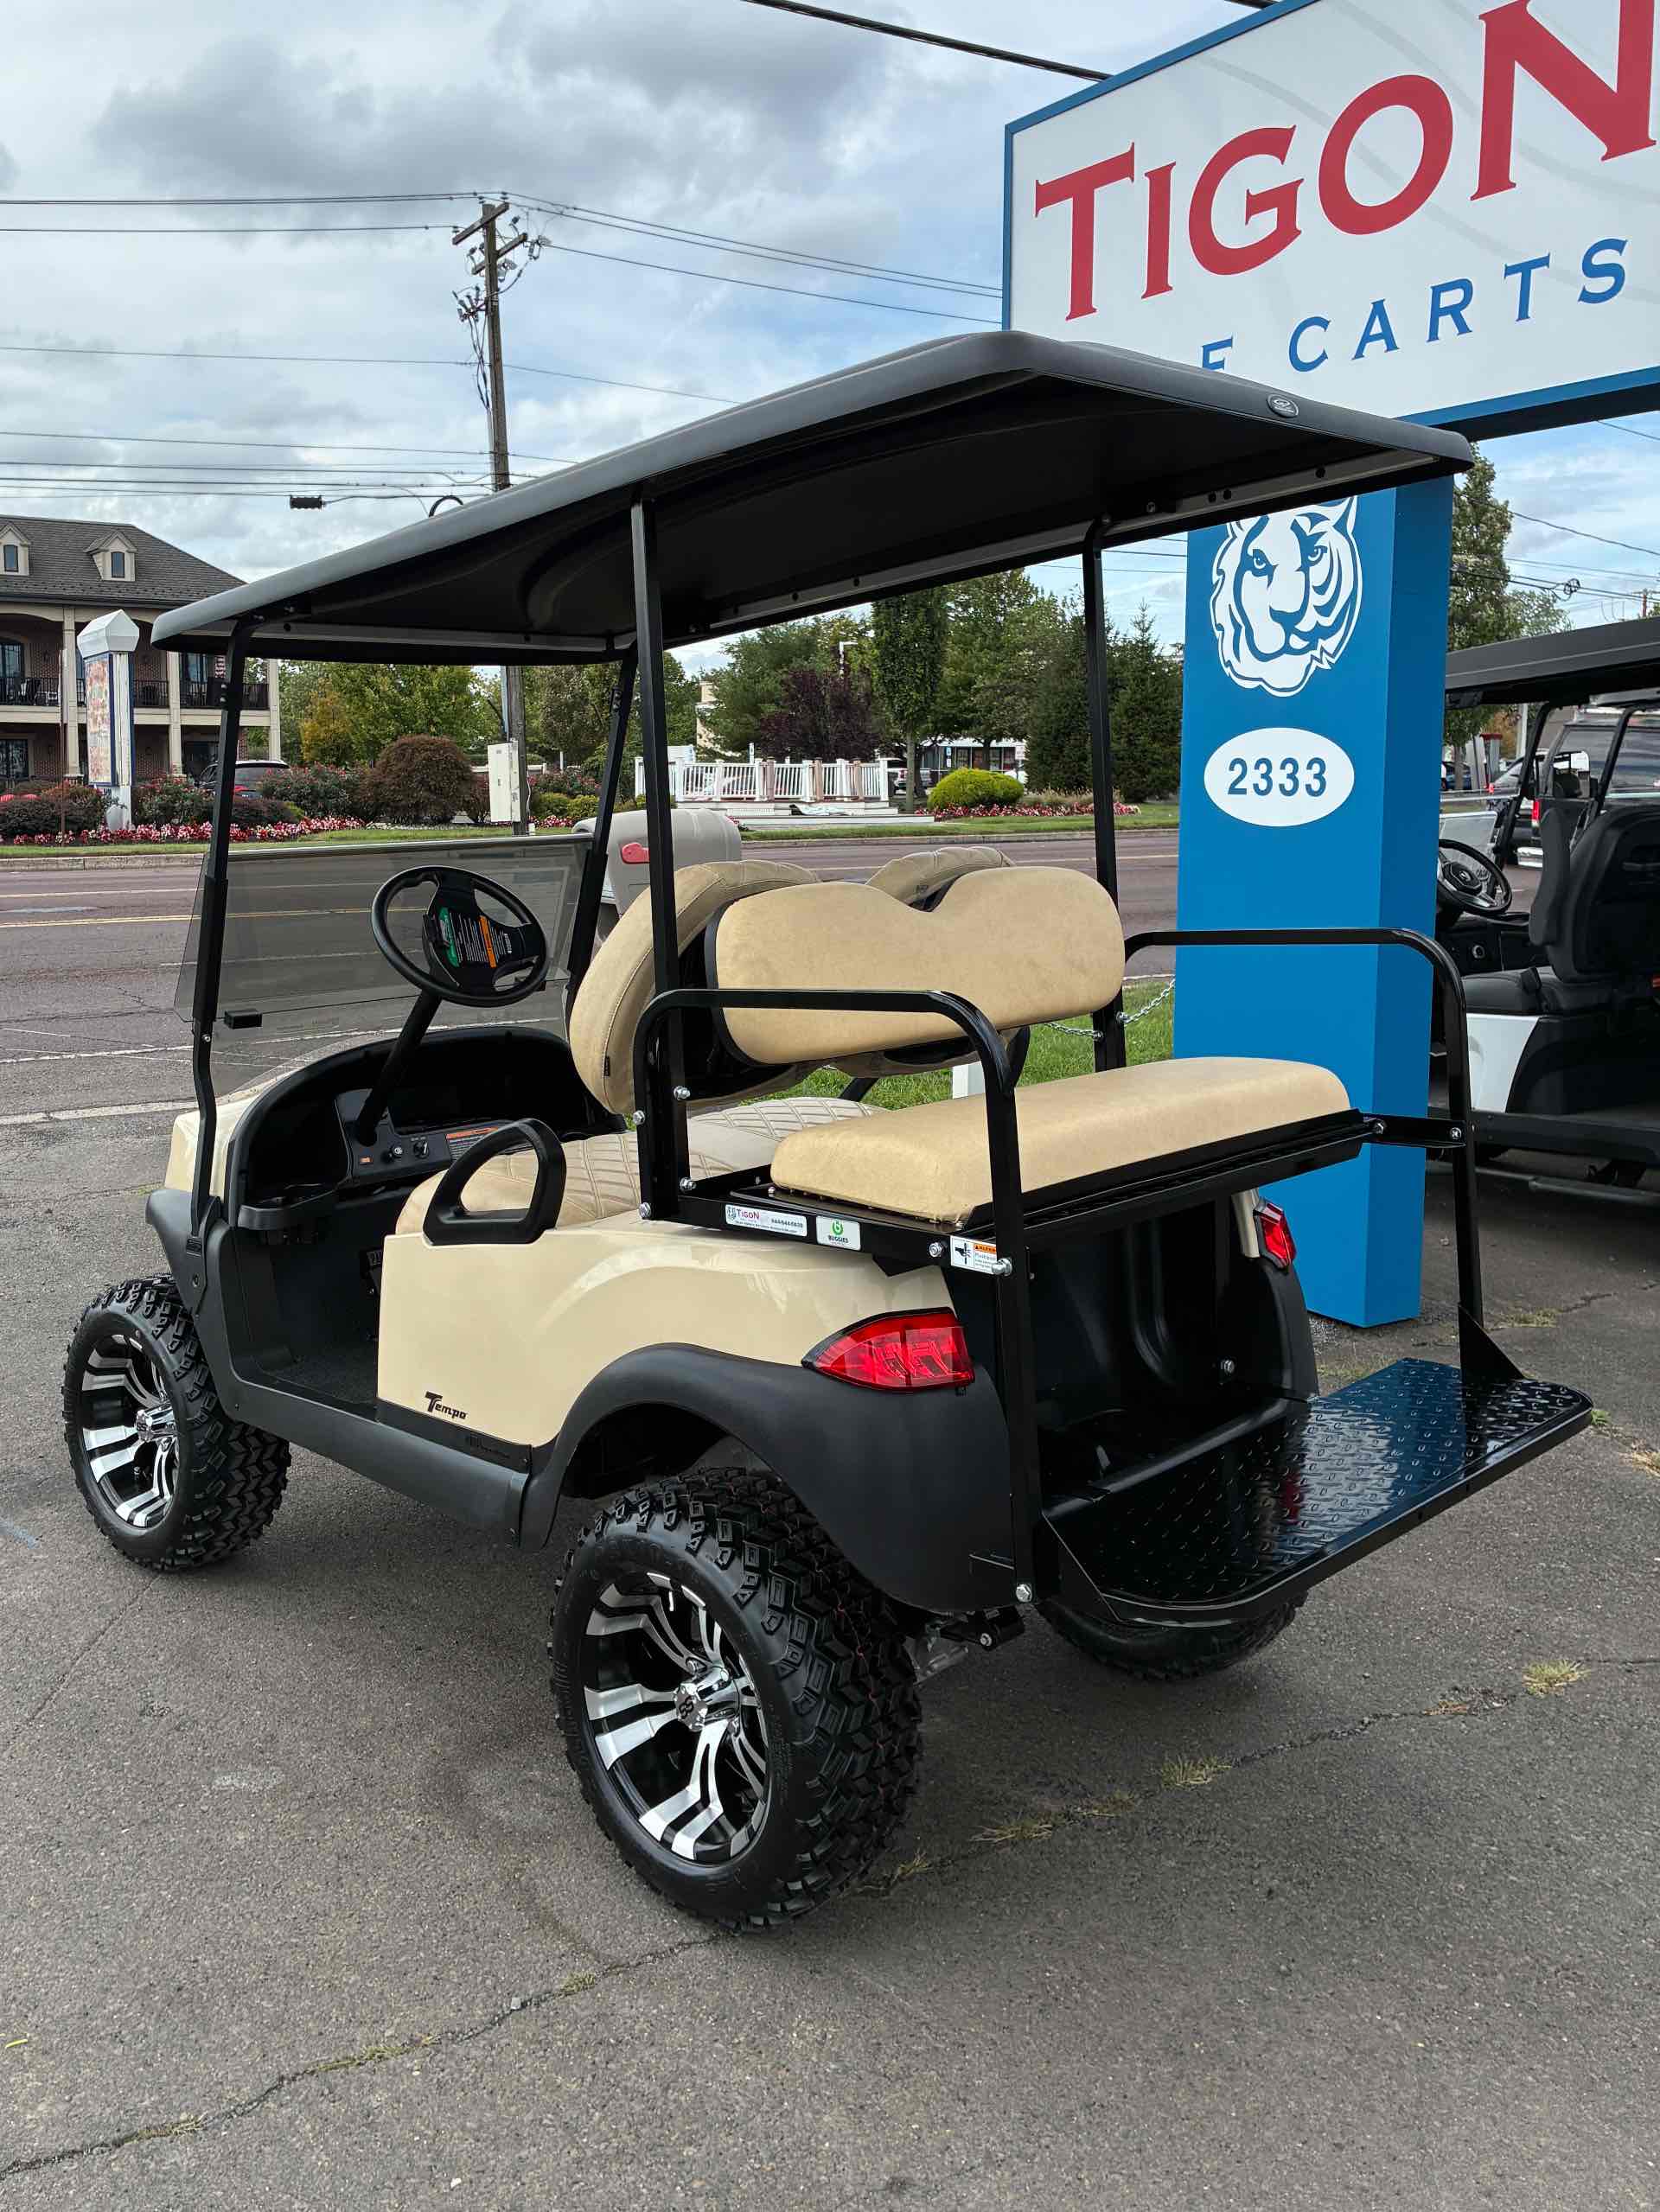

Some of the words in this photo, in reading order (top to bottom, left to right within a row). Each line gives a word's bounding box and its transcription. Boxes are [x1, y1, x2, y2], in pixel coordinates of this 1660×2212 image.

[1035, 0, 1656, 321] TIGON
[1288, 237, 1629, 373] CARTS
[1227, 756, 1327, 798] 2333
[736, 1208, 761, 1221] TIGON
[425, 1391, 468, 1419] Tempo
